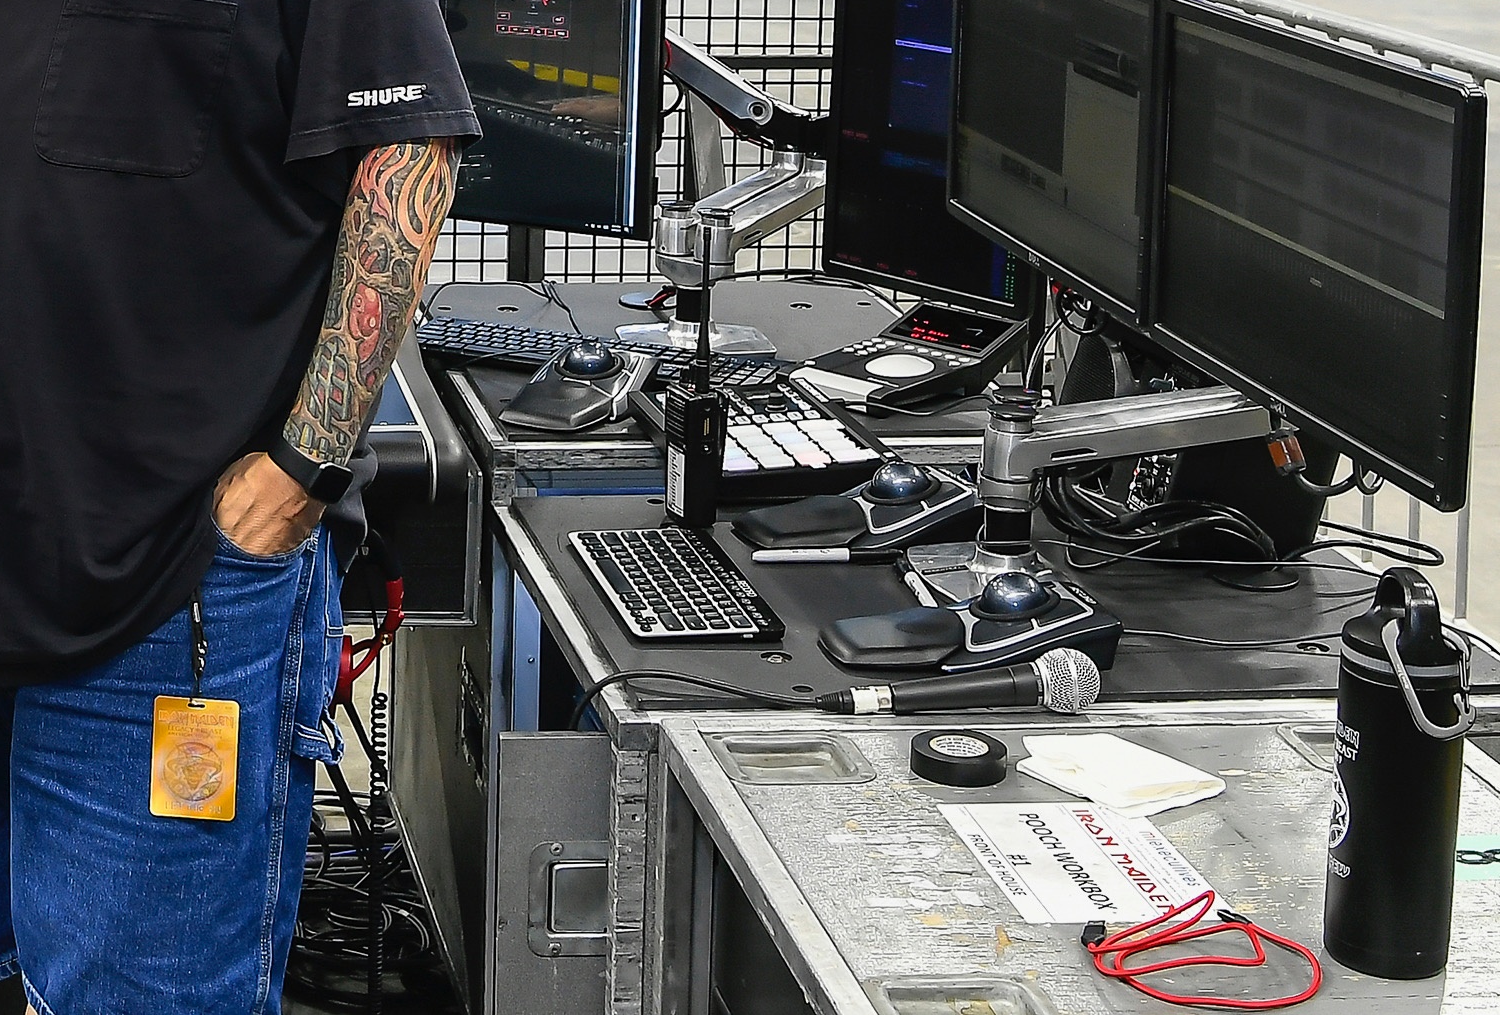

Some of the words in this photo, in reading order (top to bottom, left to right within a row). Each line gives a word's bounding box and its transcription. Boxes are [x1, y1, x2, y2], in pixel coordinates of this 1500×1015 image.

[347, 84, 426, 108] SHURE
[966, 833, 998, 860] FRONT
[1005, 853, 1032, 866] #1
[988, 859, 1006, 870] OF
[1018, 813, 1066, 851] POOCH
[1053, 852, 1116, 911] WORKBOX
[1071, 809, 1119, 846] IRON
[1111, 853, 1177, 915] MAIDEN
[995, 869, 1027, 896] HOUSE
